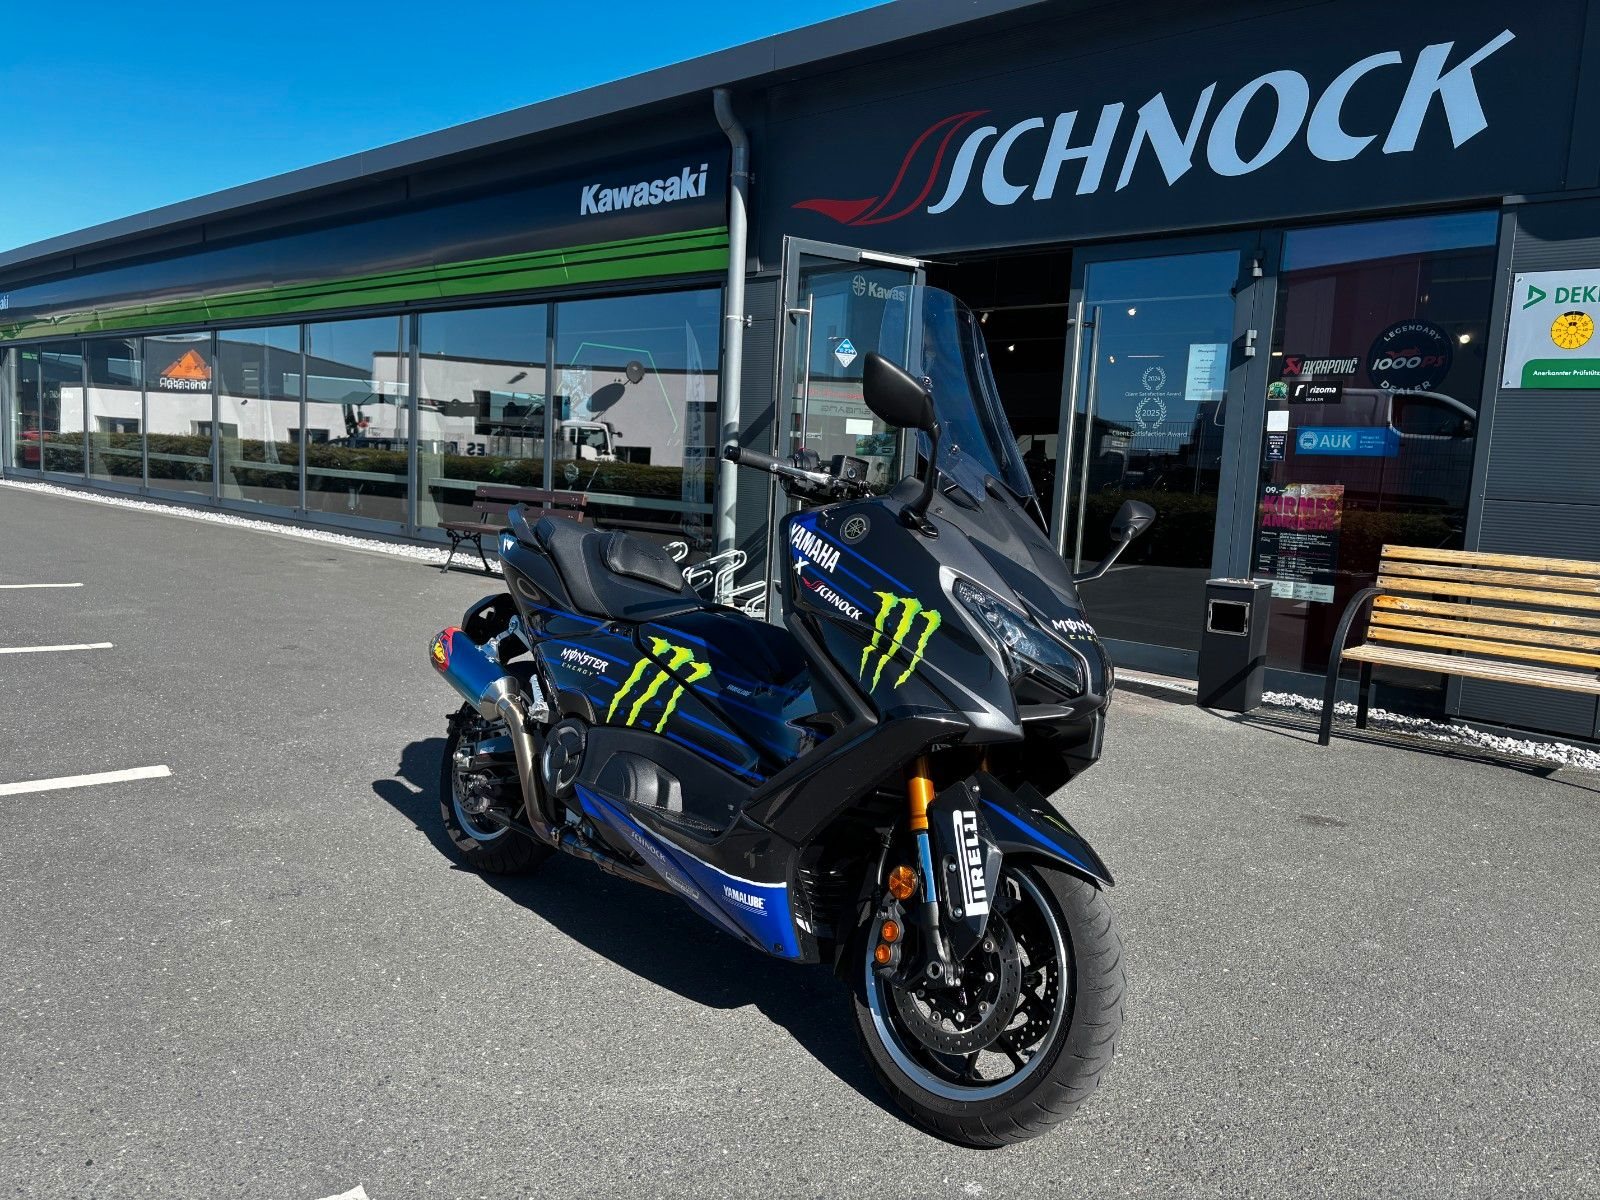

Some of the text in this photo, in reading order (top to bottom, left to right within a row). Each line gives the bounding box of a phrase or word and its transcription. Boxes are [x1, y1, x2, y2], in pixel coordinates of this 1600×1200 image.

[927, 29, 1516, 214] SCHNOCK
[580, 163, 709, 216] Kawasaki
[868, 281, 907, 302] Kawas
[1555, 285, 1600, 304] DEK
[1384, 325, 1441, 341] LEGENDARY
[1309, 386, 1337, 394] rizoma
[1380, 380, 1431, 395] DEALER
[791, 522, 841, 574] YAMAHA
[793, 555, 810, 576] X
[814, 584, 863, 621] SCHNOCK
[562, 662, 594, 677] ENERGY
[952, 809, 989, 917] PIRELLI
[723, 884, 766, 910] YAMALUBE
